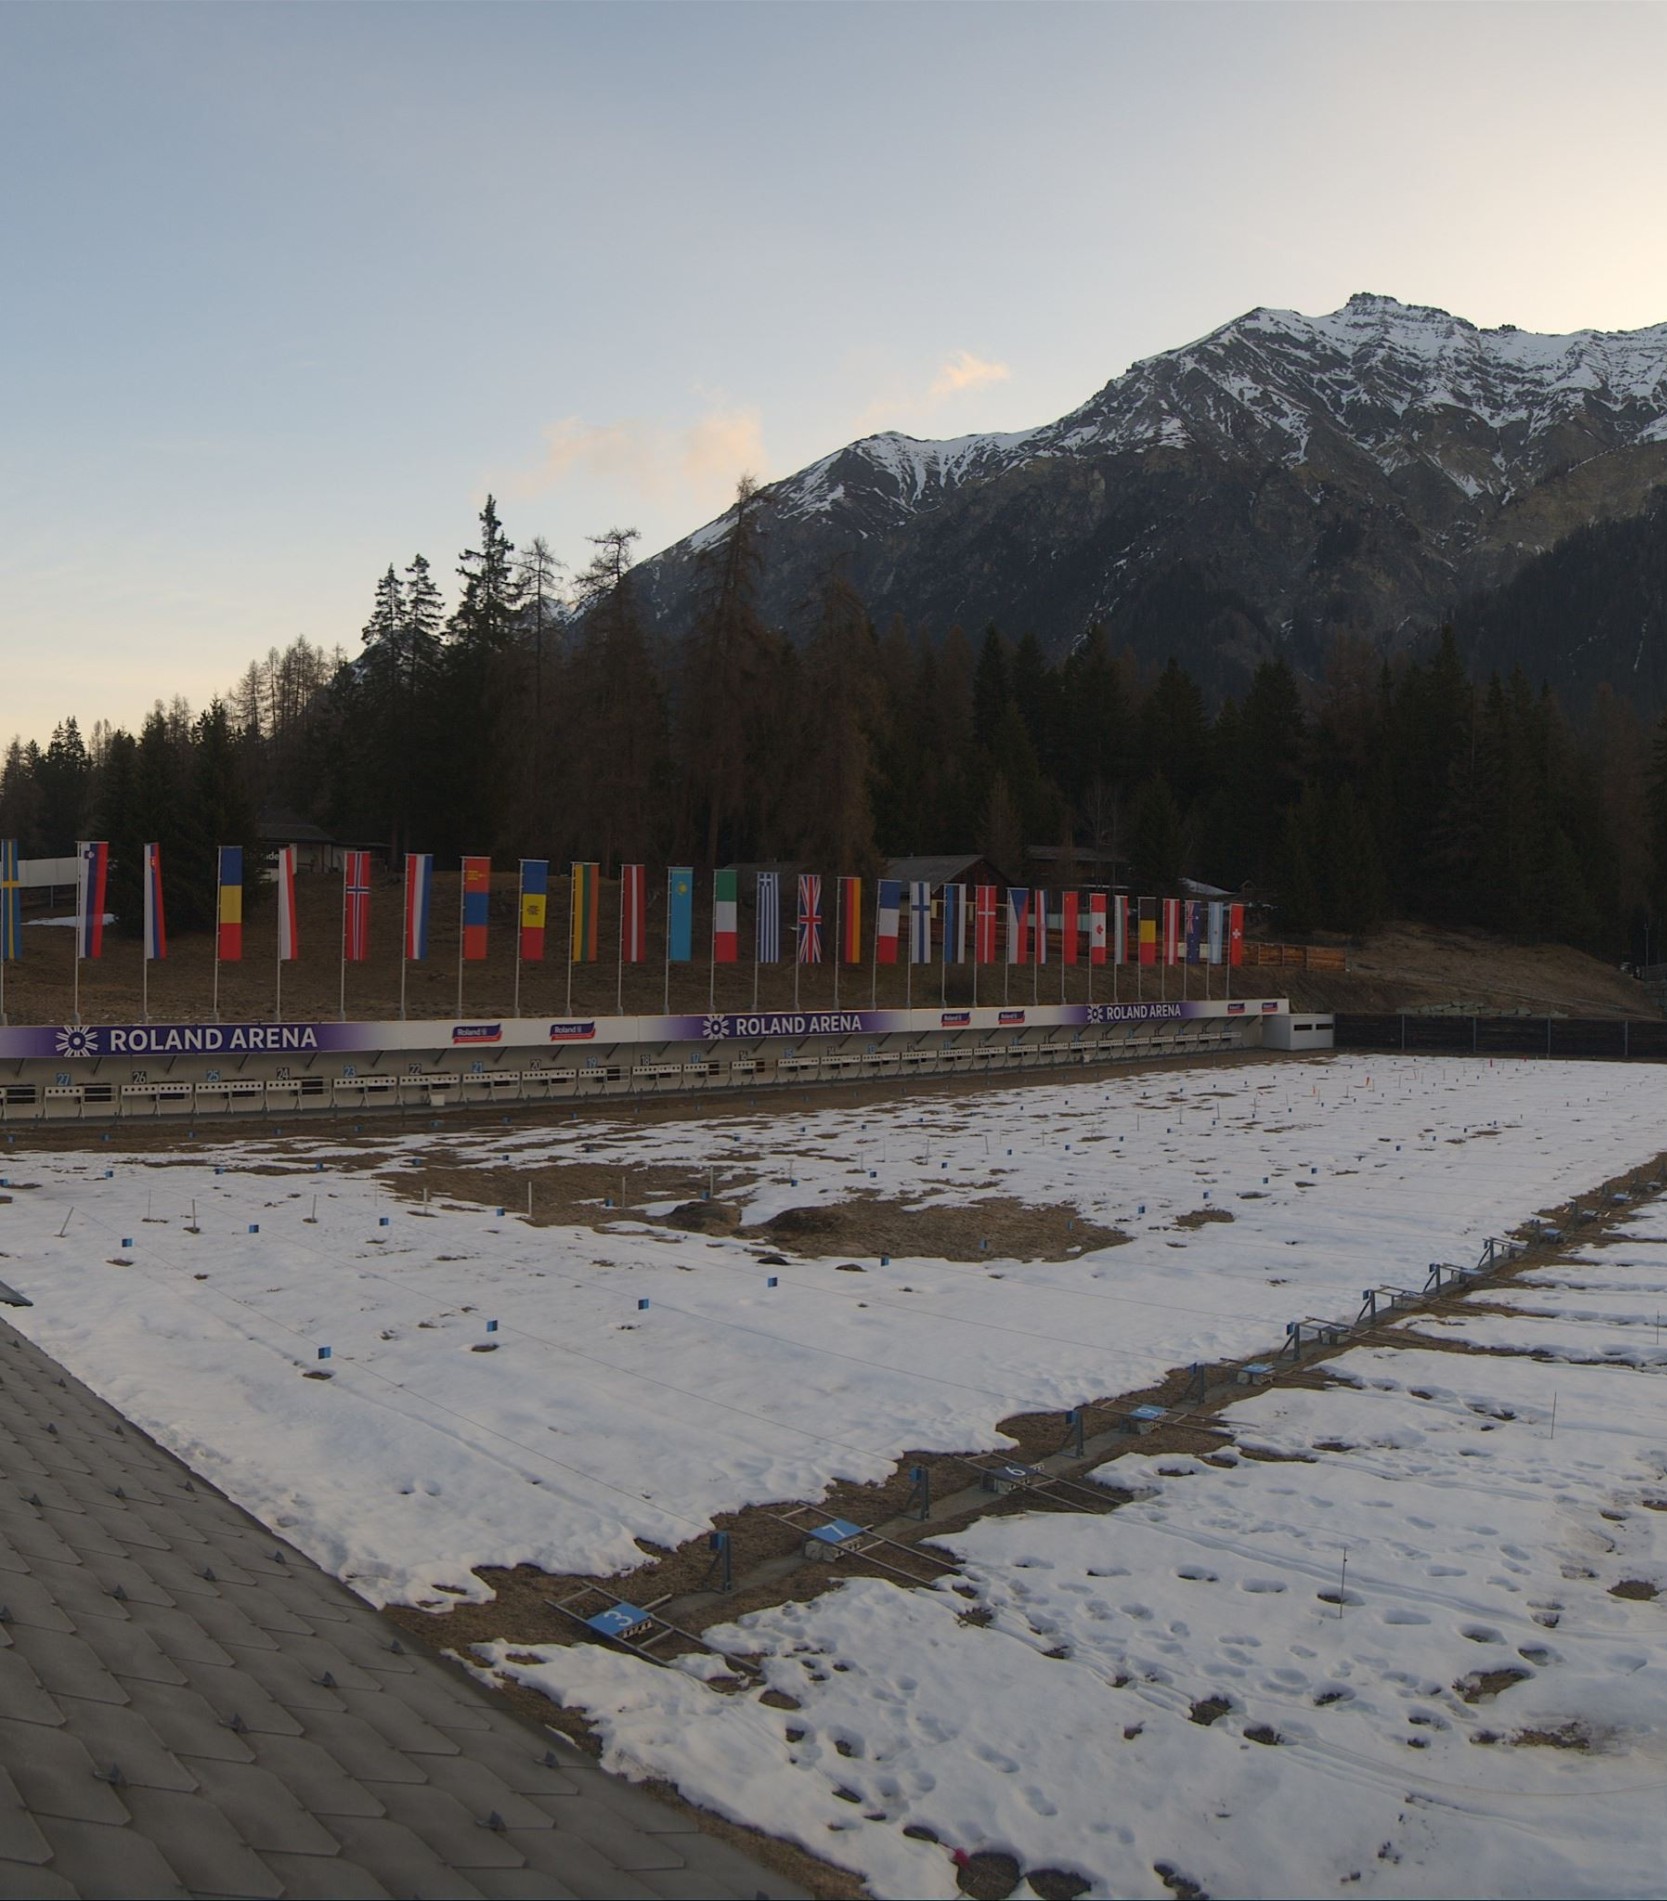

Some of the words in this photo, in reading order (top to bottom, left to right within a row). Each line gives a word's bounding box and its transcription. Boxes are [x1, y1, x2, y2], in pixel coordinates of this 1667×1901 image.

[1107, 1003, 1148, 1020] ROLAND
[1149, 1001, 1181, 1018] ARENA
[554, 1026, 576, 1034] Roland
[736, 1016, 805, 1036] ROLAND
[809, 1014, 863, 1033] ARENA
[457, 1028, 480, 1036] Roland
[110, 1027, 223, 1052] ROLAND
[229, 1027, 318, 1049] ARENA
[207, 1070, 220, 1082] 25
[277, 1067, 290, 1080] 24
[344, 1066, 356, 1078] 23
[410, 1064, 421, 1076] 22
[57, 1074, 70, 1085] 27
[133, 1072, 146, 1084] 26
